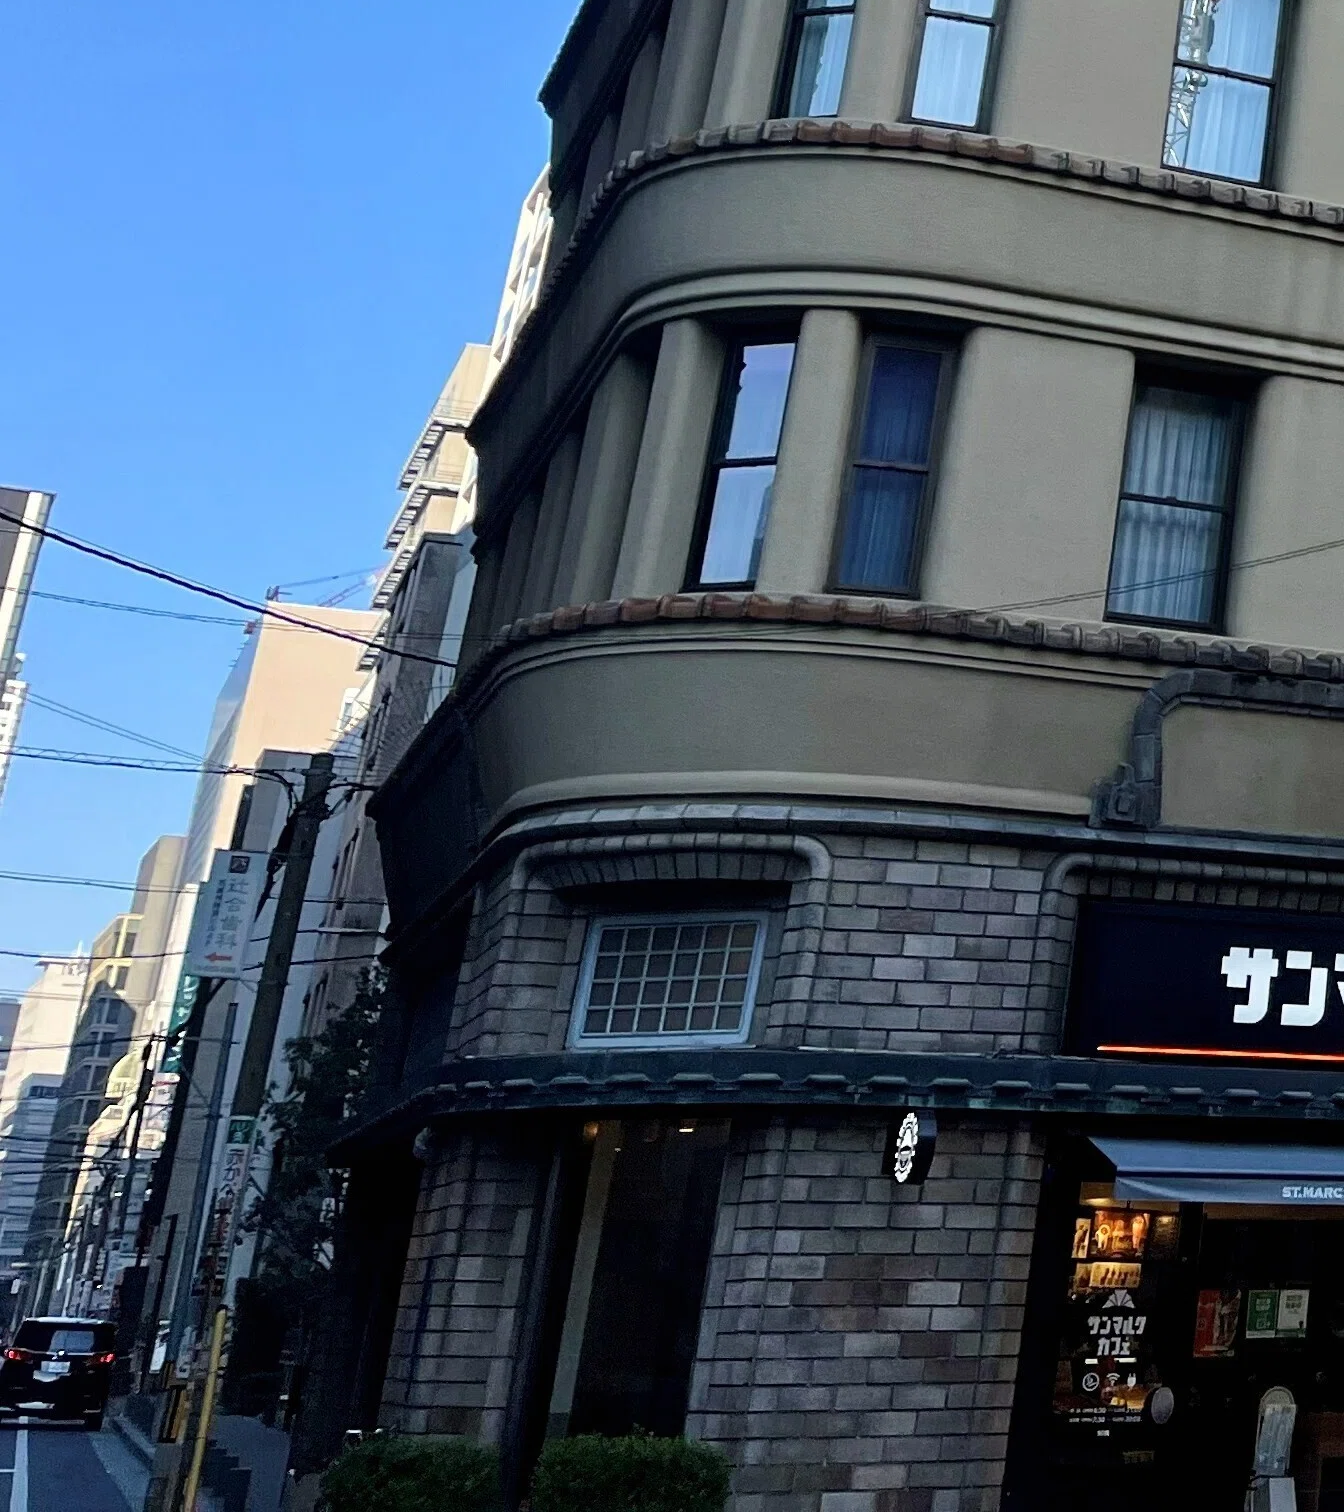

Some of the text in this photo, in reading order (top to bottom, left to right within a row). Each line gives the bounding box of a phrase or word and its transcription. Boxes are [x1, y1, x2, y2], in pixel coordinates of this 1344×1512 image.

[1281, 1185, 1344, 1200] ST.MARC
[1086, 1315, 1147, 1336] サンマルク
[1096, 1336, 1131, 1357] カフェ
